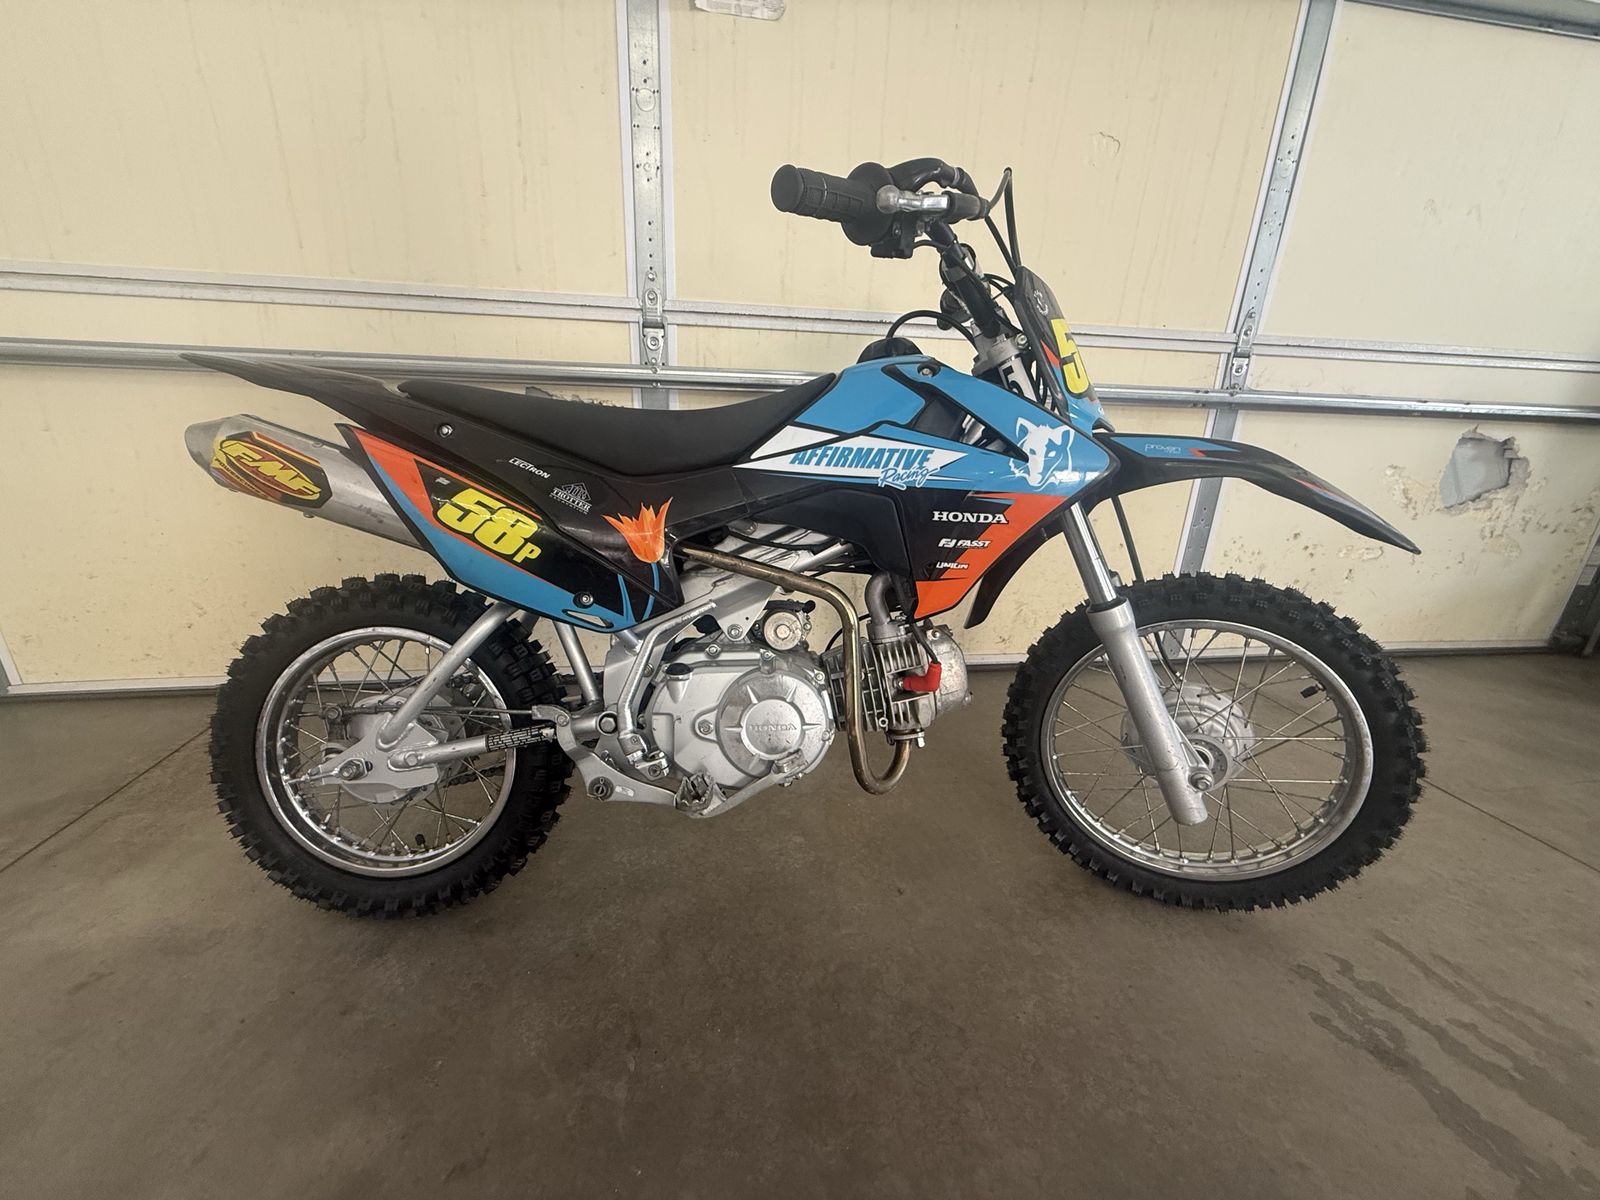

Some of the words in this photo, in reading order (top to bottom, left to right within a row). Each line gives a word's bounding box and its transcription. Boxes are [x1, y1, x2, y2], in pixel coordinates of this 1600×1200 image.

[219, 442, 321, 496] FMF
[509, 457, 550, 479] LECTRON
[789, 446, 934, 470] AFFIRMATIVE
[878, 467, 939, 490] Racing
[552, 488, 591, 511] TROTTER
[932, 511, 1008, 524] HONDA
[957, 540, 991, 548] FASST
[750, 723, 797, 731] HONDA
